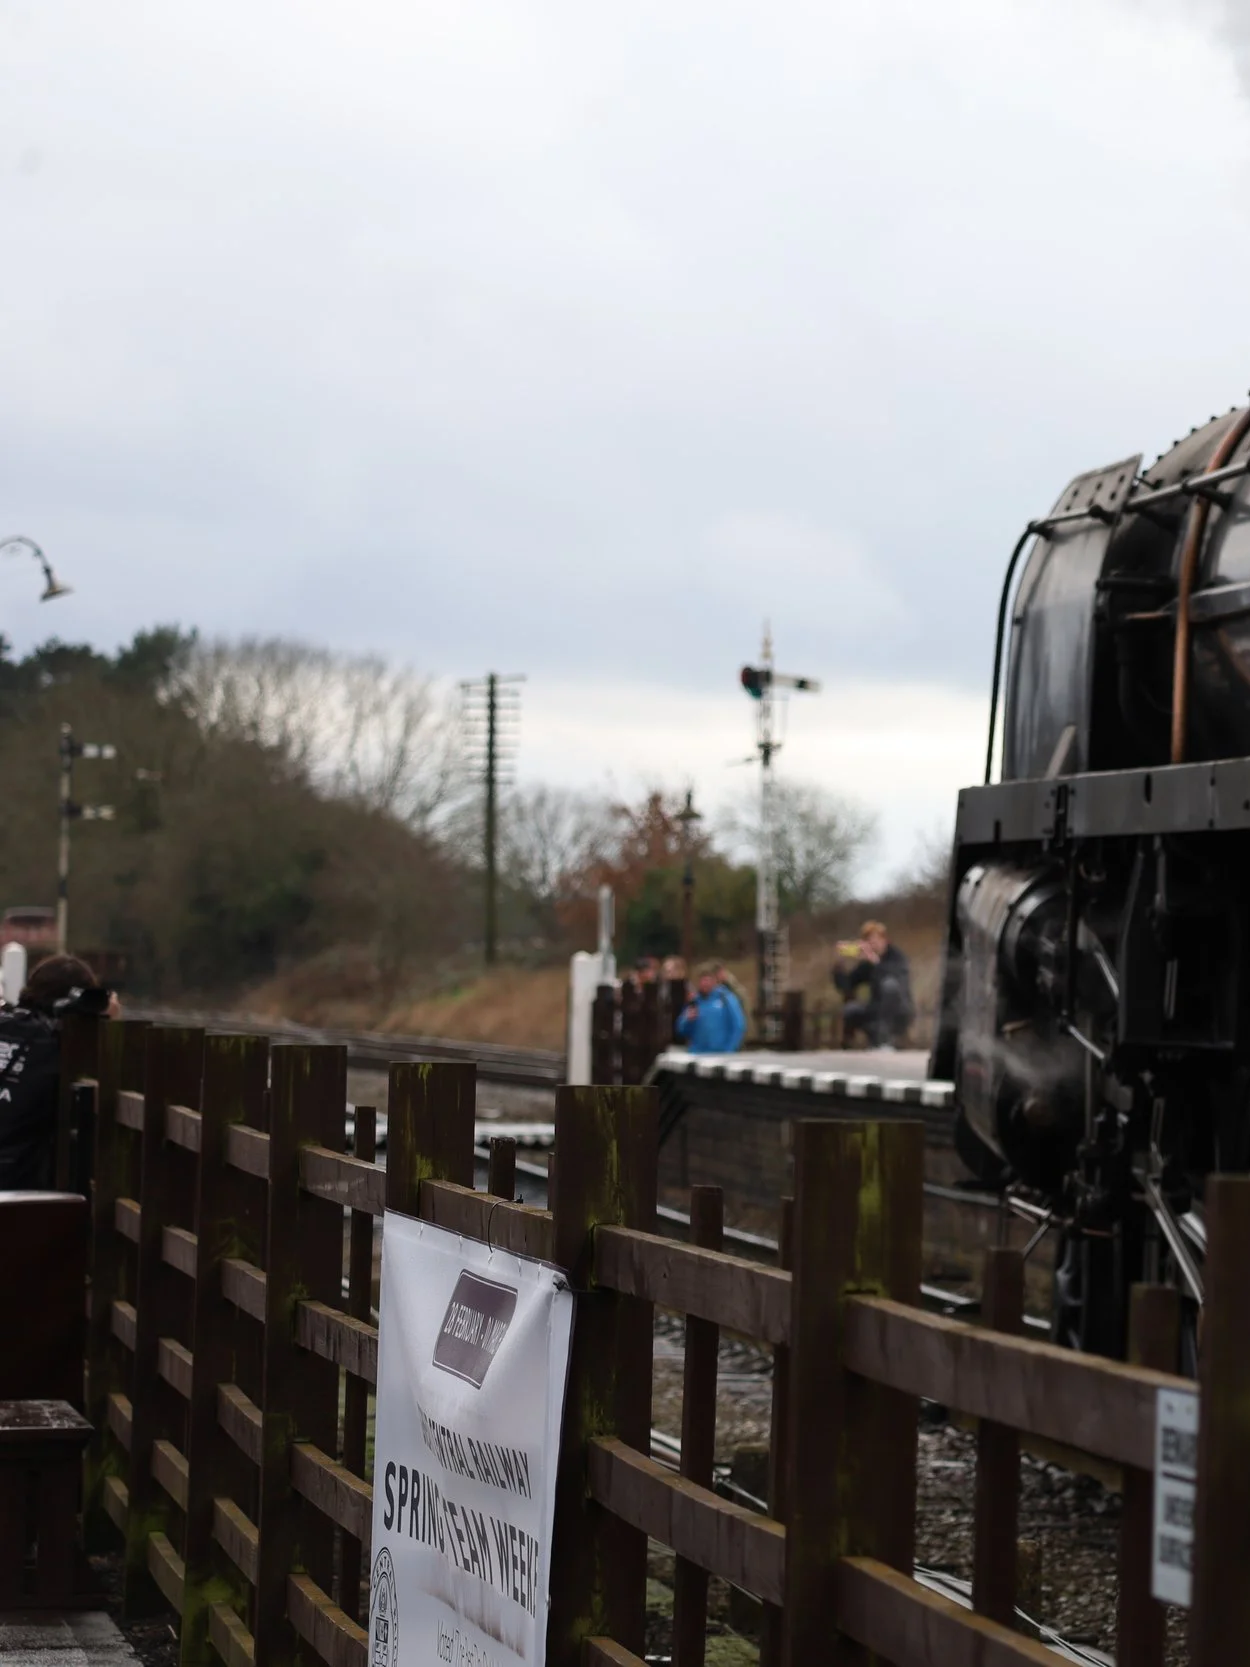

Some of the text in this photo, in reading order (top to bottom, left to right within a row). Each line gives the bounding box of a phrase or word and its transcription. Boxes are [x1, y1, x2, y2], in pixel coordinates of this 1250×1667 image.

[467, 1437, 532, 1500] RAILWAY
[384, 1460, 446, 1554] SPRING
[443, 1494, 494, 1585] TEAM
